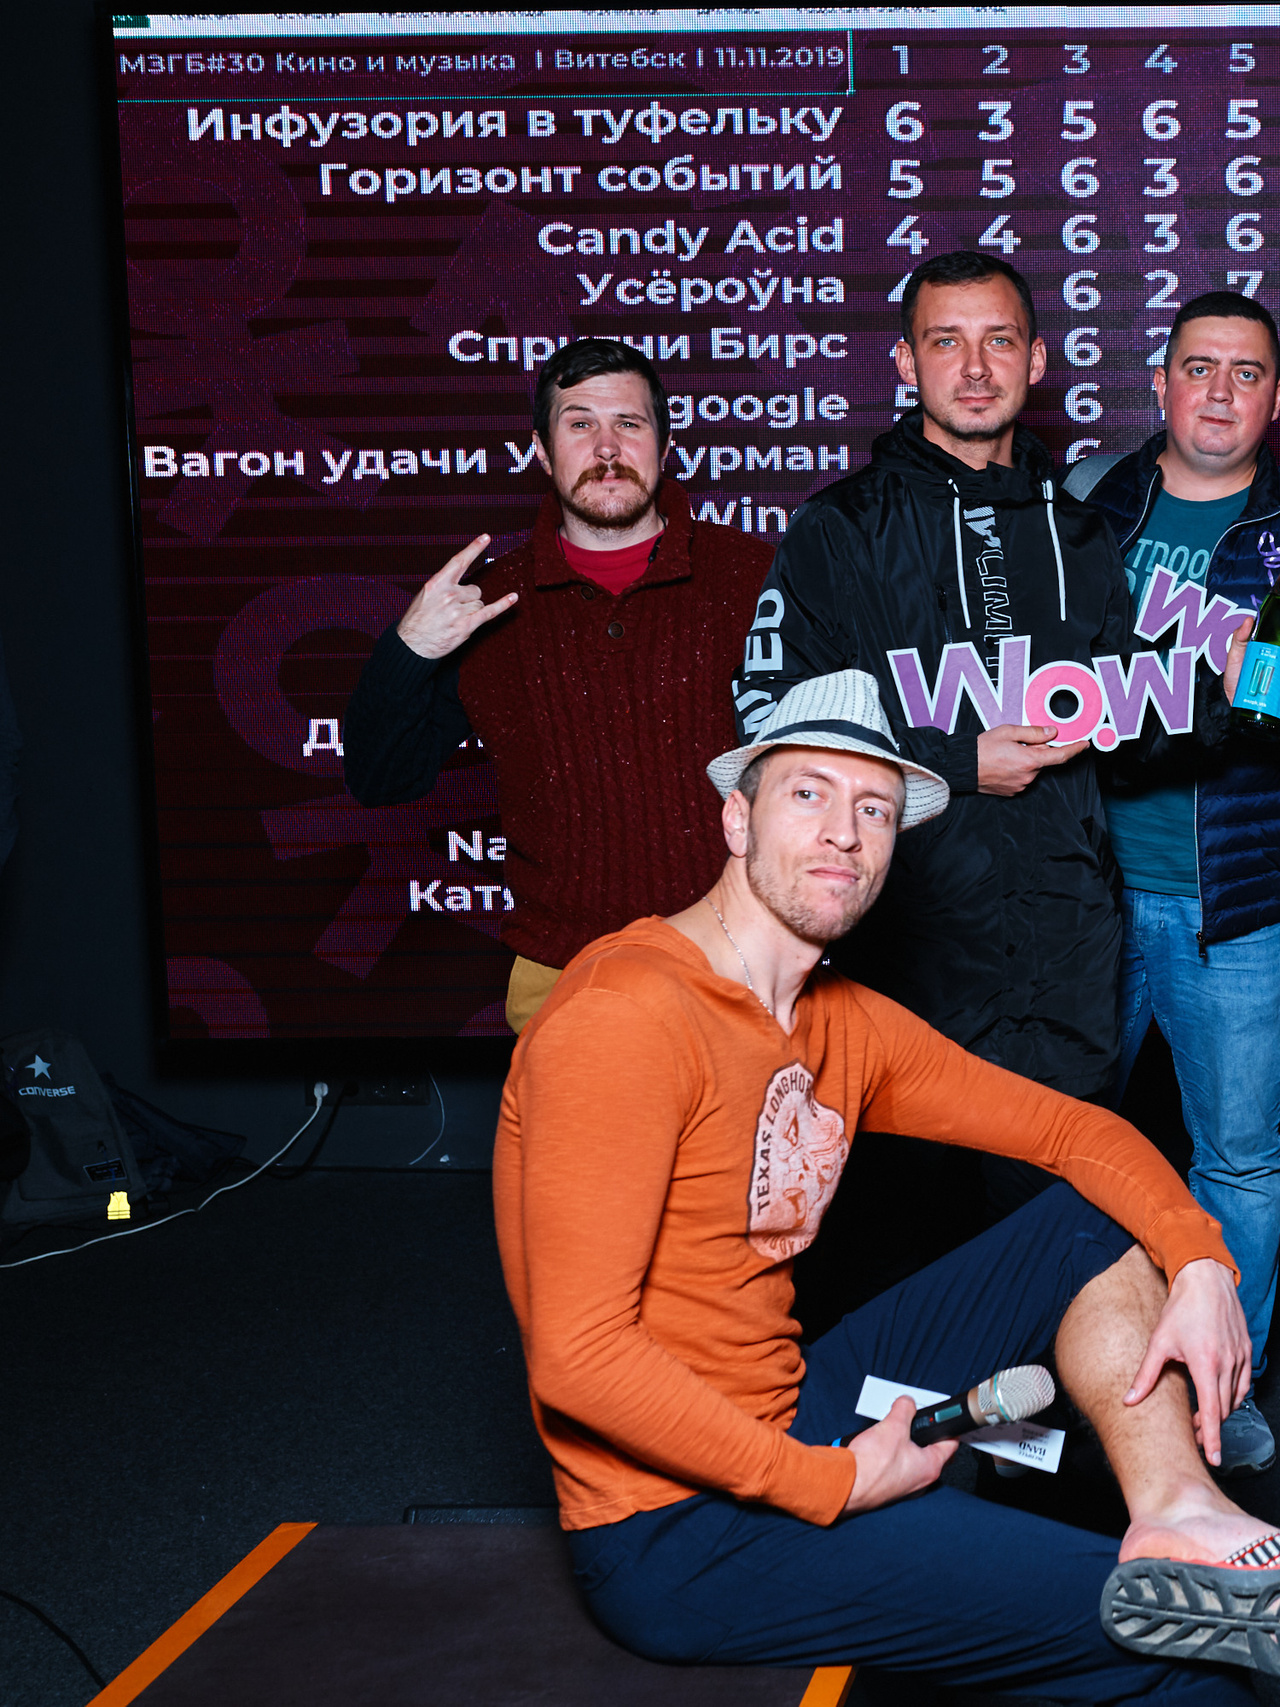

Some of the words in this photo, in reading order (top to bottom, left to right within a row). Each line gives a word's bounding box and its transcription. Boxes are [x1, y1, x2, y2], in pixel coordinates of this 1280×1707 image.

[121, 54, 265, 73] МЗГБ#30
[276, 53, 356, 72] Кино
[368, 56, 385, 71] и
[397, 54, 516, 76] музыка
[556, 47, 685, 69] Витебск
[716, 46, 844, 67] 11.11.2019
[893, 45, 909, 75] 1
[983, 44, 1010, 74] 2
[1063, 44, 1091, 74] 3
[1144, 43, 1178, 74] 4
[1228, 43, 1256, 73] 5
[187, 105, 506, 148] Инфузория
[528, 110, 556, 137] в
[573, 101, 843, 144] туфельку
[886, 101, 924, 142] 6
[978, 101, 1014, 141] 3
[1060, 100, 1097, 141] 5
[1142, 99, 1181, 140] 6
[1225, 99, 1262, 139] 5
[321, 163, 581, 203] Горизонт
[598, 154, 842, 192] событий
[888, 159, 924, 199] 5
[980, 159, 1016, 198] 5
[1061, 157, 1100, 198] 6
[1143, 158, 1179, 198] 3
[1225, 155, 1264, 196] 6
[538, 220, 709, 262] Candy
[725, 216, 844, 253] Acid
[886, 215, 929, 255] 4
[978, 214, 1021, 254] 4
[1062, 214, 1101, 254] 6
[1144, 213, 1180, 253] 3
[1226, 212, 1264, 252] 6
[578, 267, 845, 311] Усёроўна
[1063, 269, 1101, 311] 6
[1144, 269, 1181, 309] 2
[1227, 270, 1263, 299] 7
[448, 331, 690, 370] Спрни
[711, 327, 848, 368] Бирс
[1064, 327, 1102, 367] 6
[1065, 382, 1103, 423] 6
[144, 445, 305, 477] Вагон
[322, 449, 487, 484] удачи
[669, 440, 849, 480] урман
[690, 496, 787, 533] Win
[1124, 537, 1211, 580] TDOO
[448, 830, 507, 861] Na
[409, 881, 515, 911] Кат
[18, 1085, 76, 1098] CONVERSE
[756, 1129, 773, 1216] TEXAS
